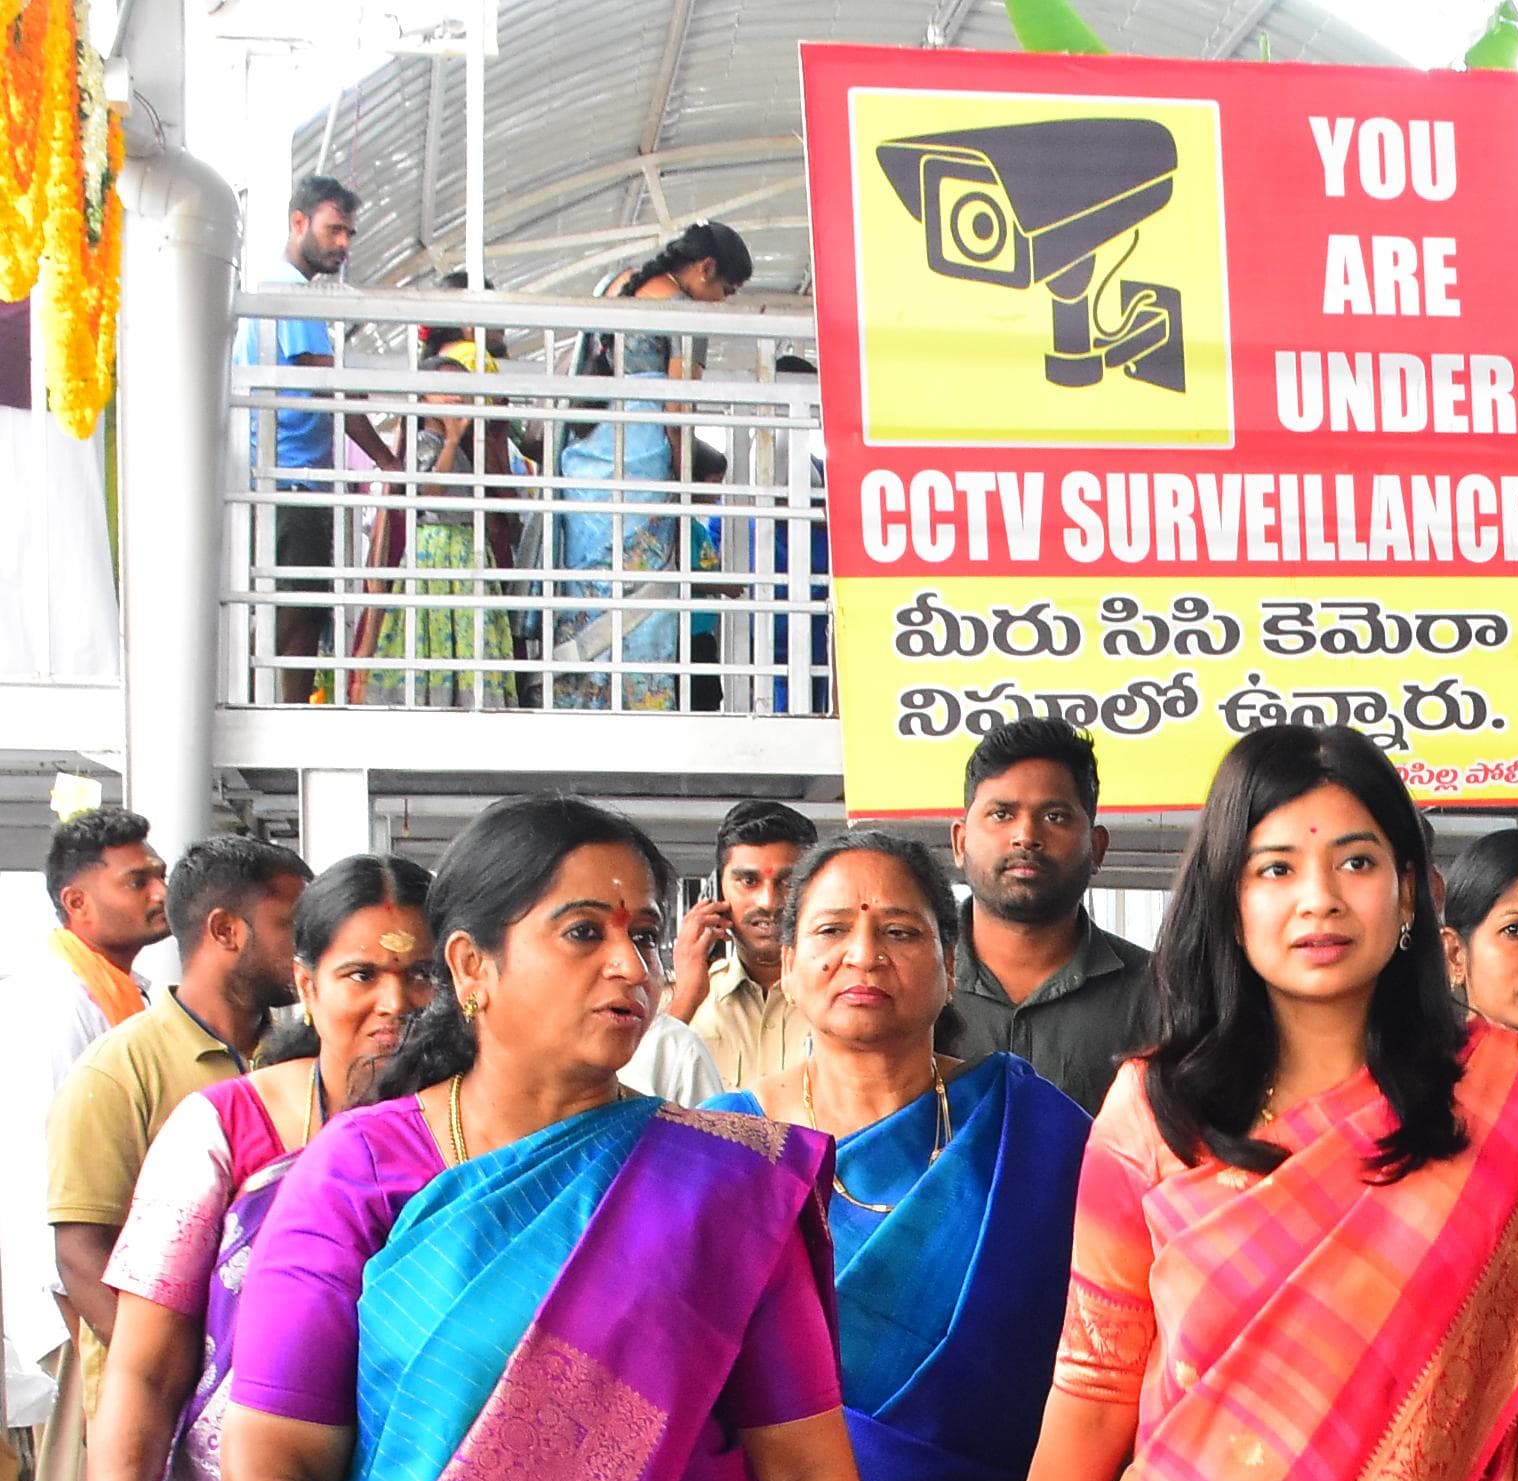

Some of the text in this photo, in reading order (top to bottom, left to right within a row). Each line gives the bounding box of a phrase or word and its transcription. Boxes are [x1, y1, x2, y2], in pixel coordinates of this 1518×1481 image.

[1309, 117, 1456, 201] YOU
[1323, 235, 1460, 316] ARE
[1276, 352, 1516, 433] UNDER
[861, 470, 1044, 562] CCTV
[896, 593, 1507, 656] మీరు సిసి కెమెరా
